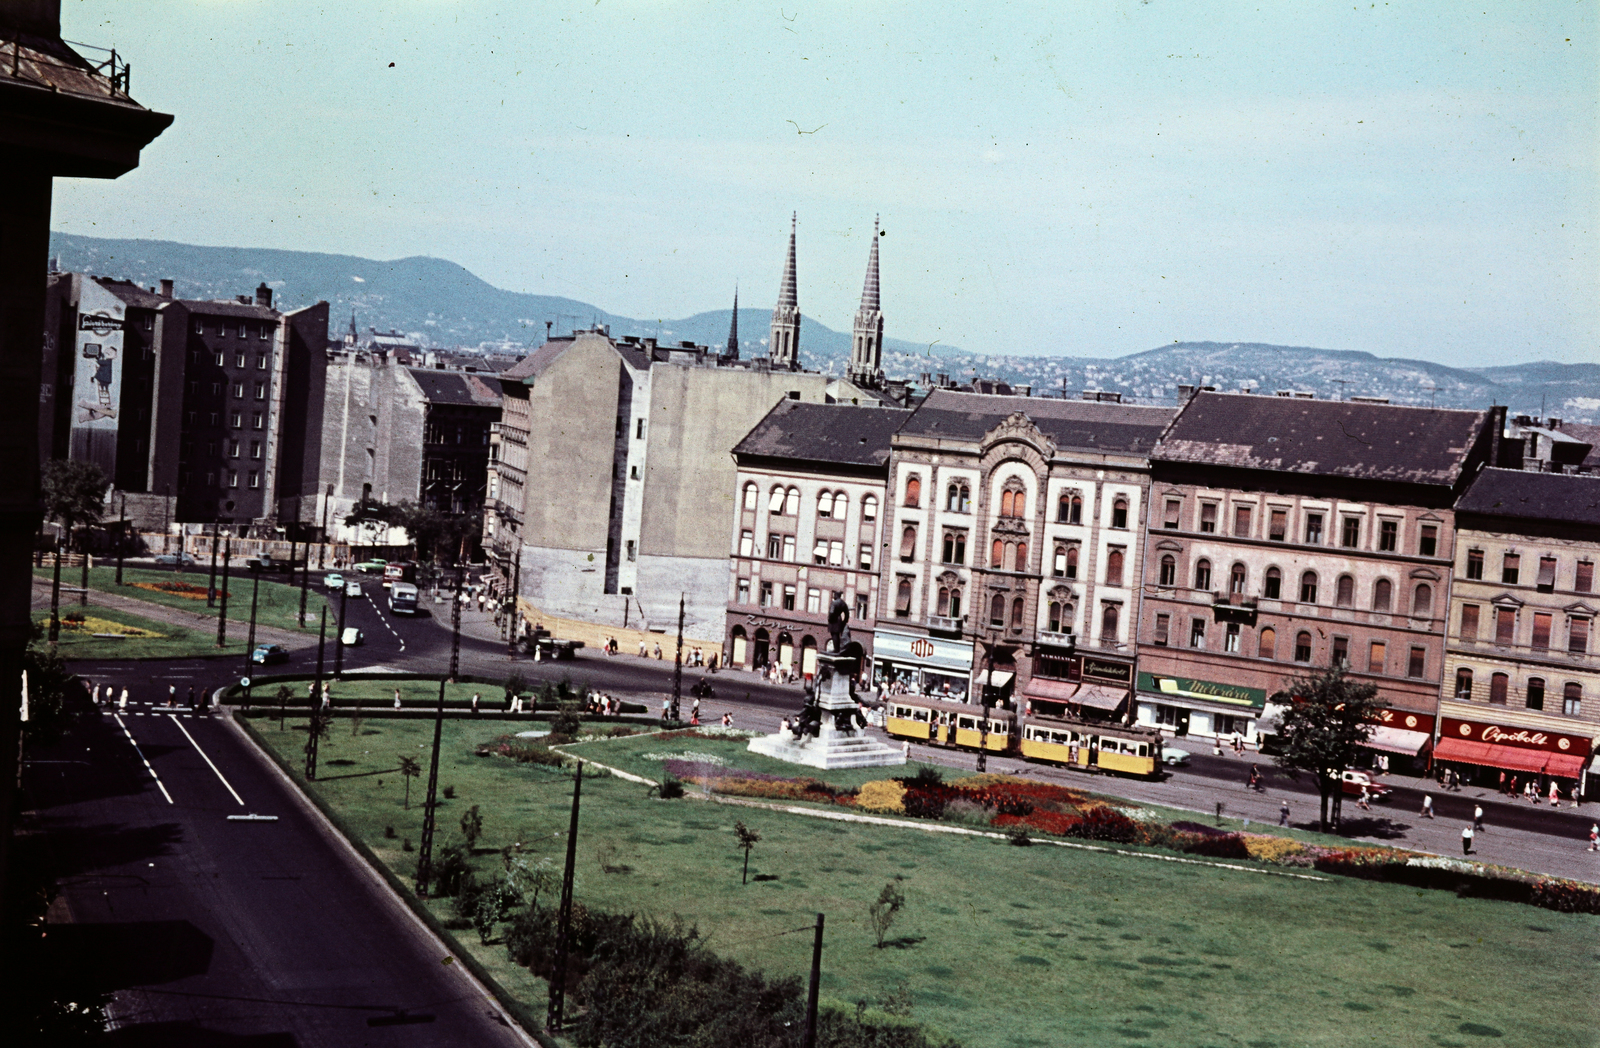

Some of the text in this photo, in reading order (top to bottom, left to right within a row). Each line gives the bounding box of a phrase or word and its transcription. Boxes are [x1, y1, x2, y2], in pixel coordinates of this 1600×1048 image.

[910, 638, 934, 658] FOTO
[1185, 680, 1251, 700] Méteráru
[1481, 725, 1548, 745] Cipőbolt
